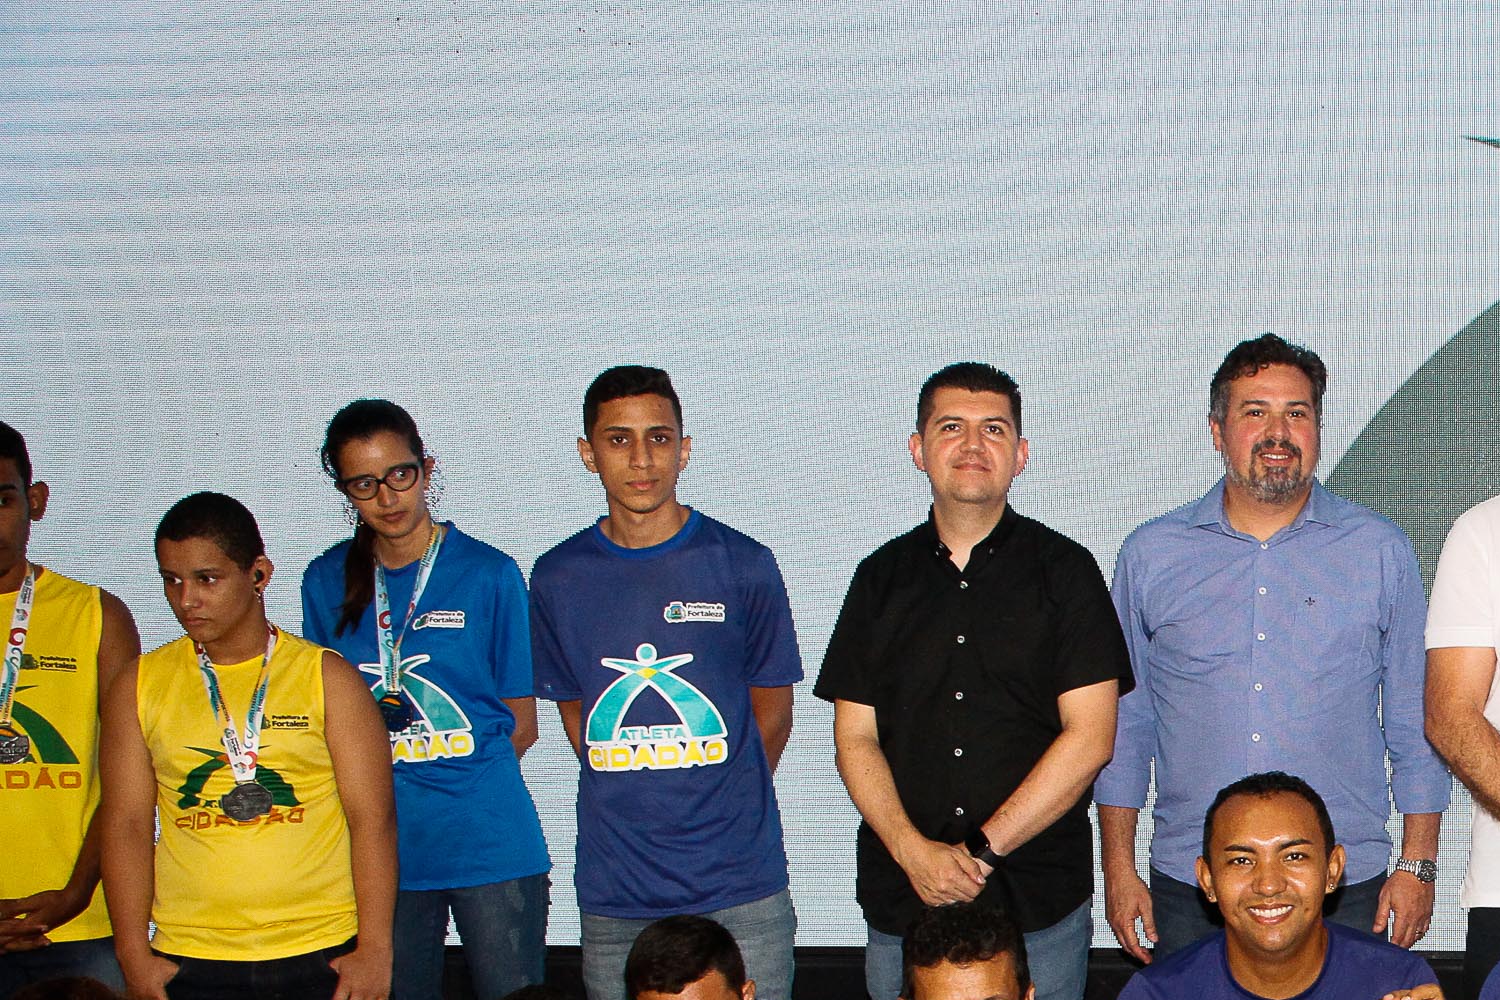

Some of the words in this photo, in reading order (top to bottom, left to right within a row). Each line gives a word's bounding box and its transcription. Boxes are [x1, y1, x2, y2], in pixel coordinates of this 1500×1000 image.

[688, 610, 723, 618] Fortaleza
[39, 662, 77, 670] Fortaleza
[272, 720, 309, 728] Fortaleza
[619, 727, 687, 741] ATLETA
[590, 740, 723, 768] CIDADÃO
[0, 767, 82, 789] DÃO
